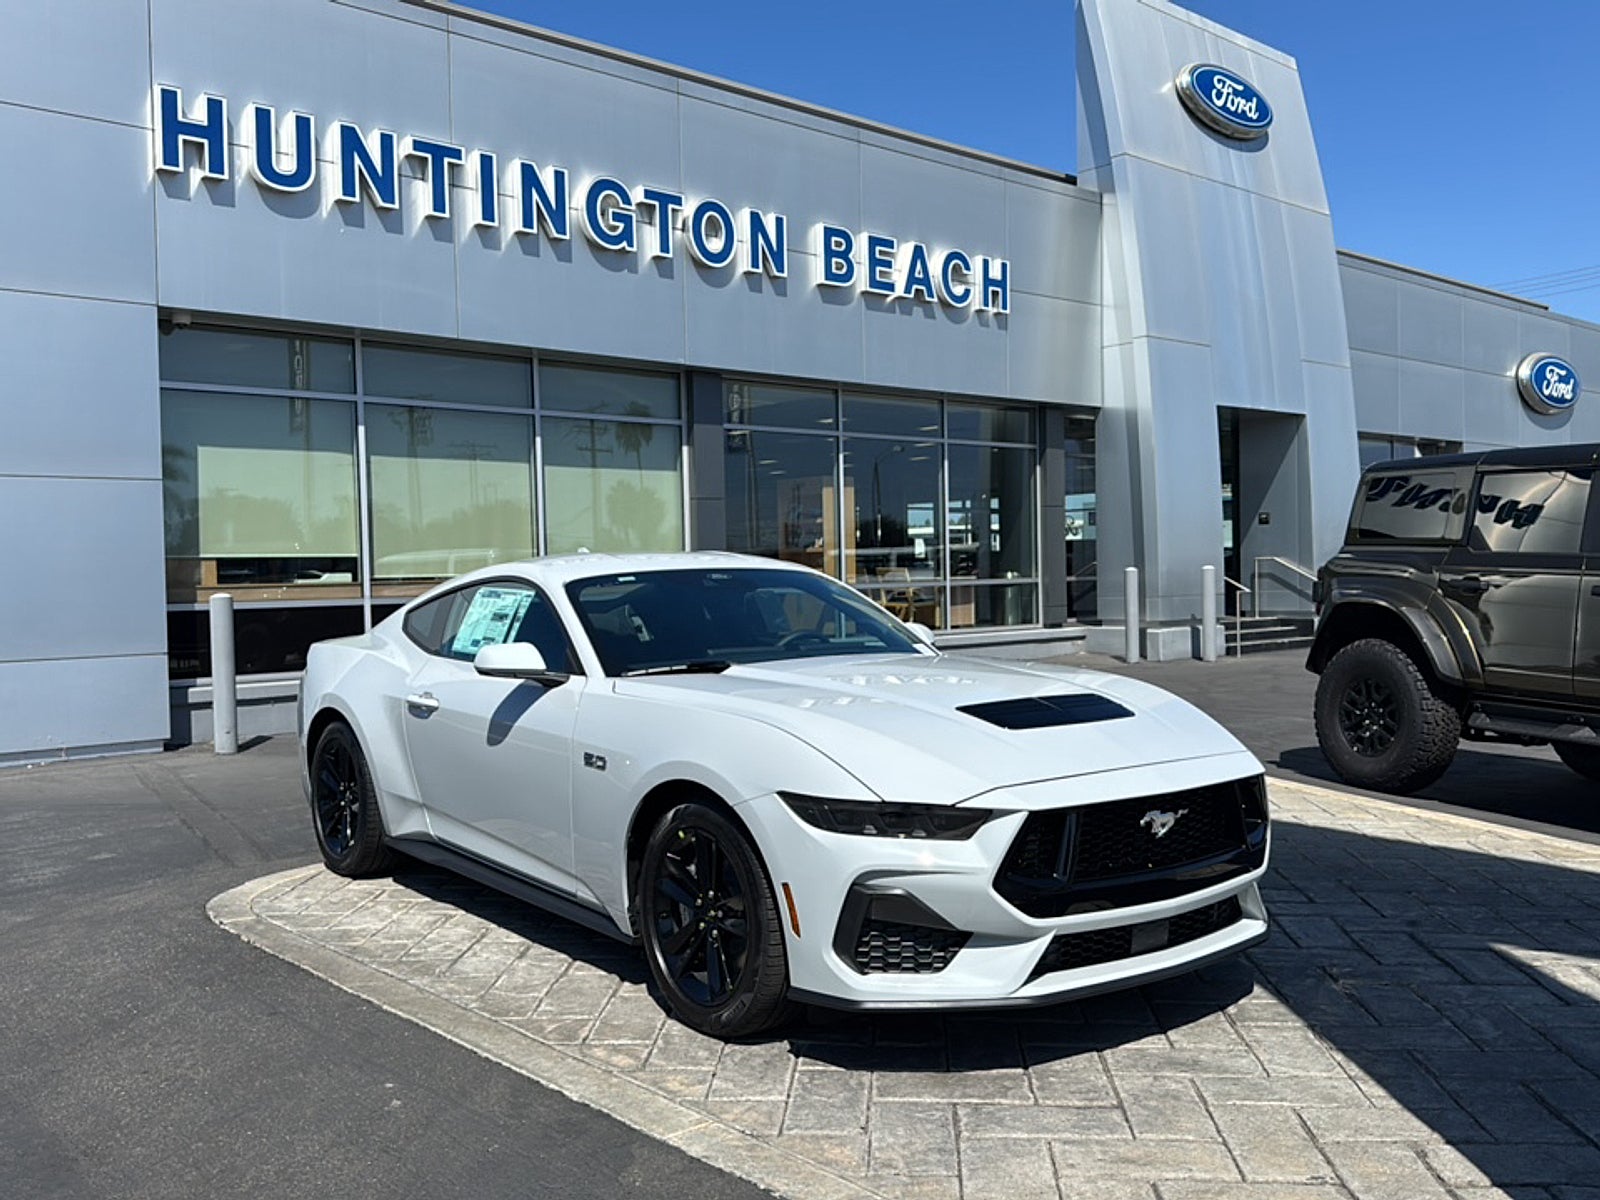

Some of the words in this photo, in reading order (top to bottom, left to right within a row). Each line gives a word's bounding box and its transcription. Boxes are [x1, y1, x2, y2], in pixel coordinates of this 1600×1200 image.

[1211, 74, 1259, 120] Ford
[157, 84, 787, 277] HUNTINGTON
[819, 222, 1010, 313] BEACH
[1542, 365, 1574, 400] Ford
